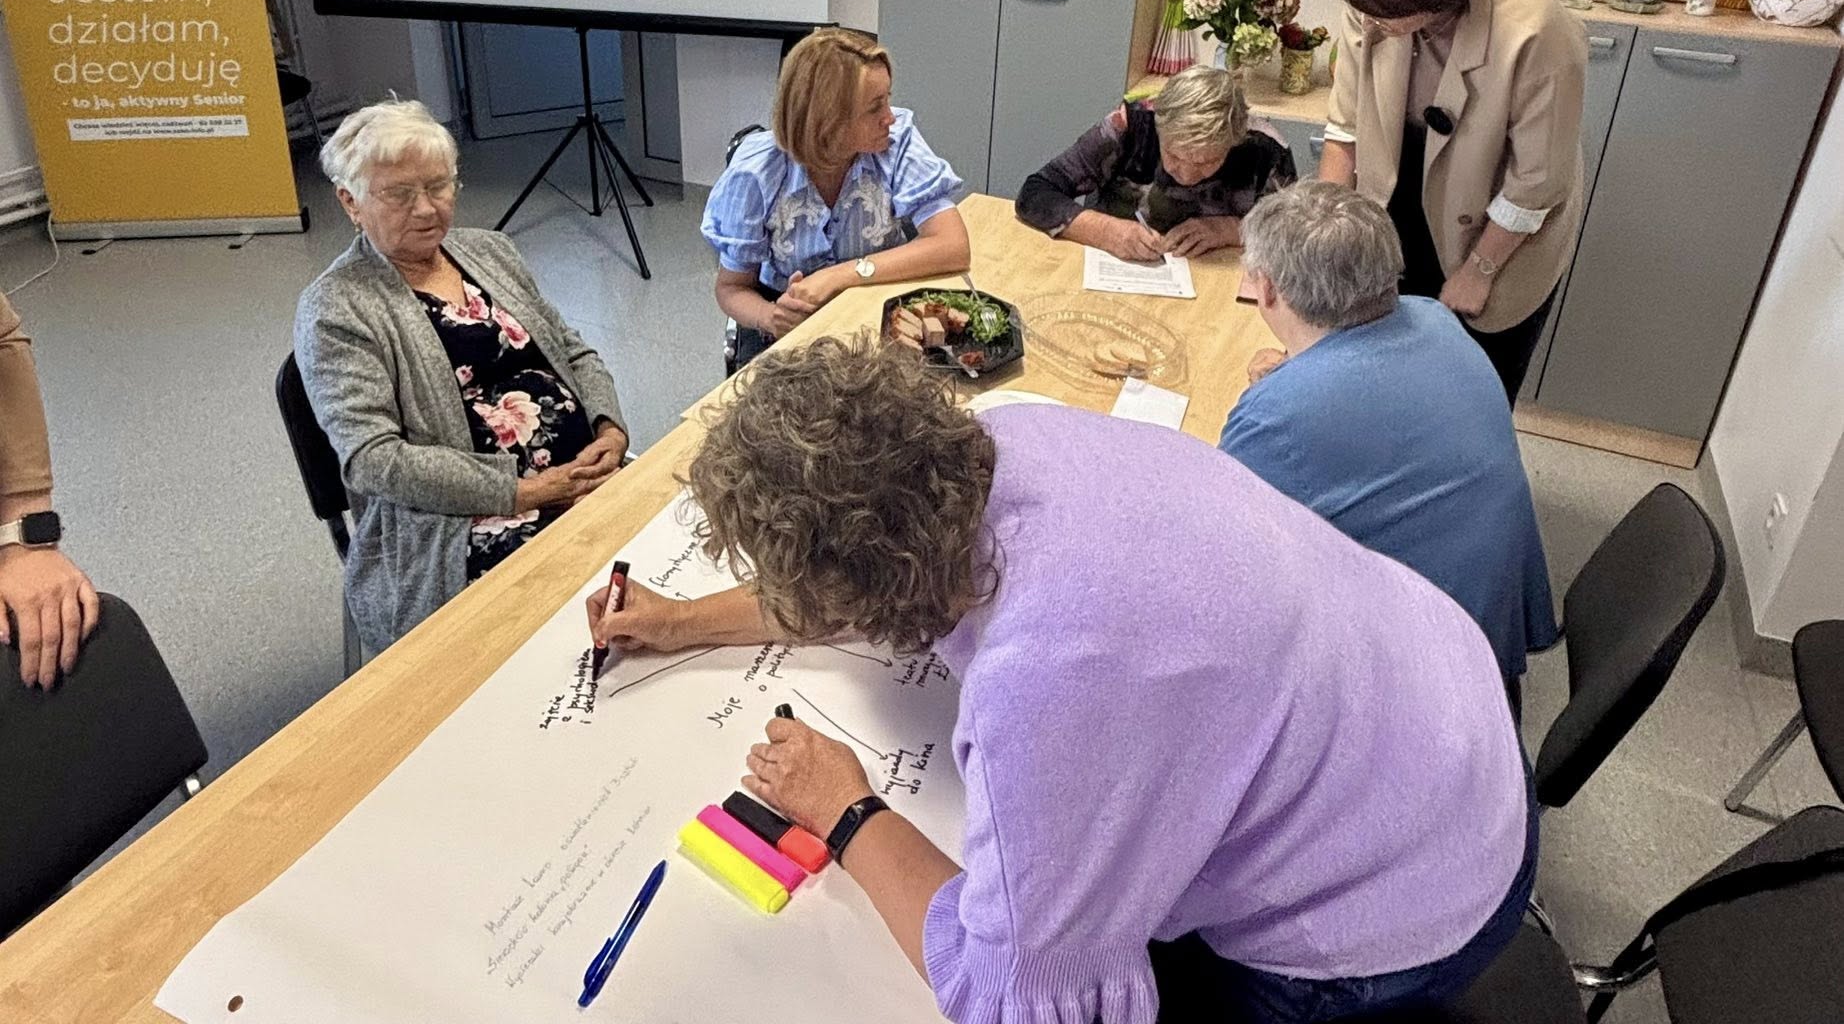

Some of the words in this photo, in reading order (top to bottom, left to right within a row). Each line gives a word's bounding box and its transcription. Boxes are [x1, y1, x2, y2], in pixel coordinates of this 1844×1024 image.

[50, 13, 230, 47] działam,
[54, 52, 241, 90] decyduję
[72, 97, 91, 109] to
[94, 95, 116, 111] ja,
[119, 95, 189, 109] aktywny
[192, 92, 246, 106] Senior
[758, 684, 768, 692] o
[706, 696, 743, 729] Moje
[909, 742, 935, 771] kina
[907, 778, 922, 795] do
